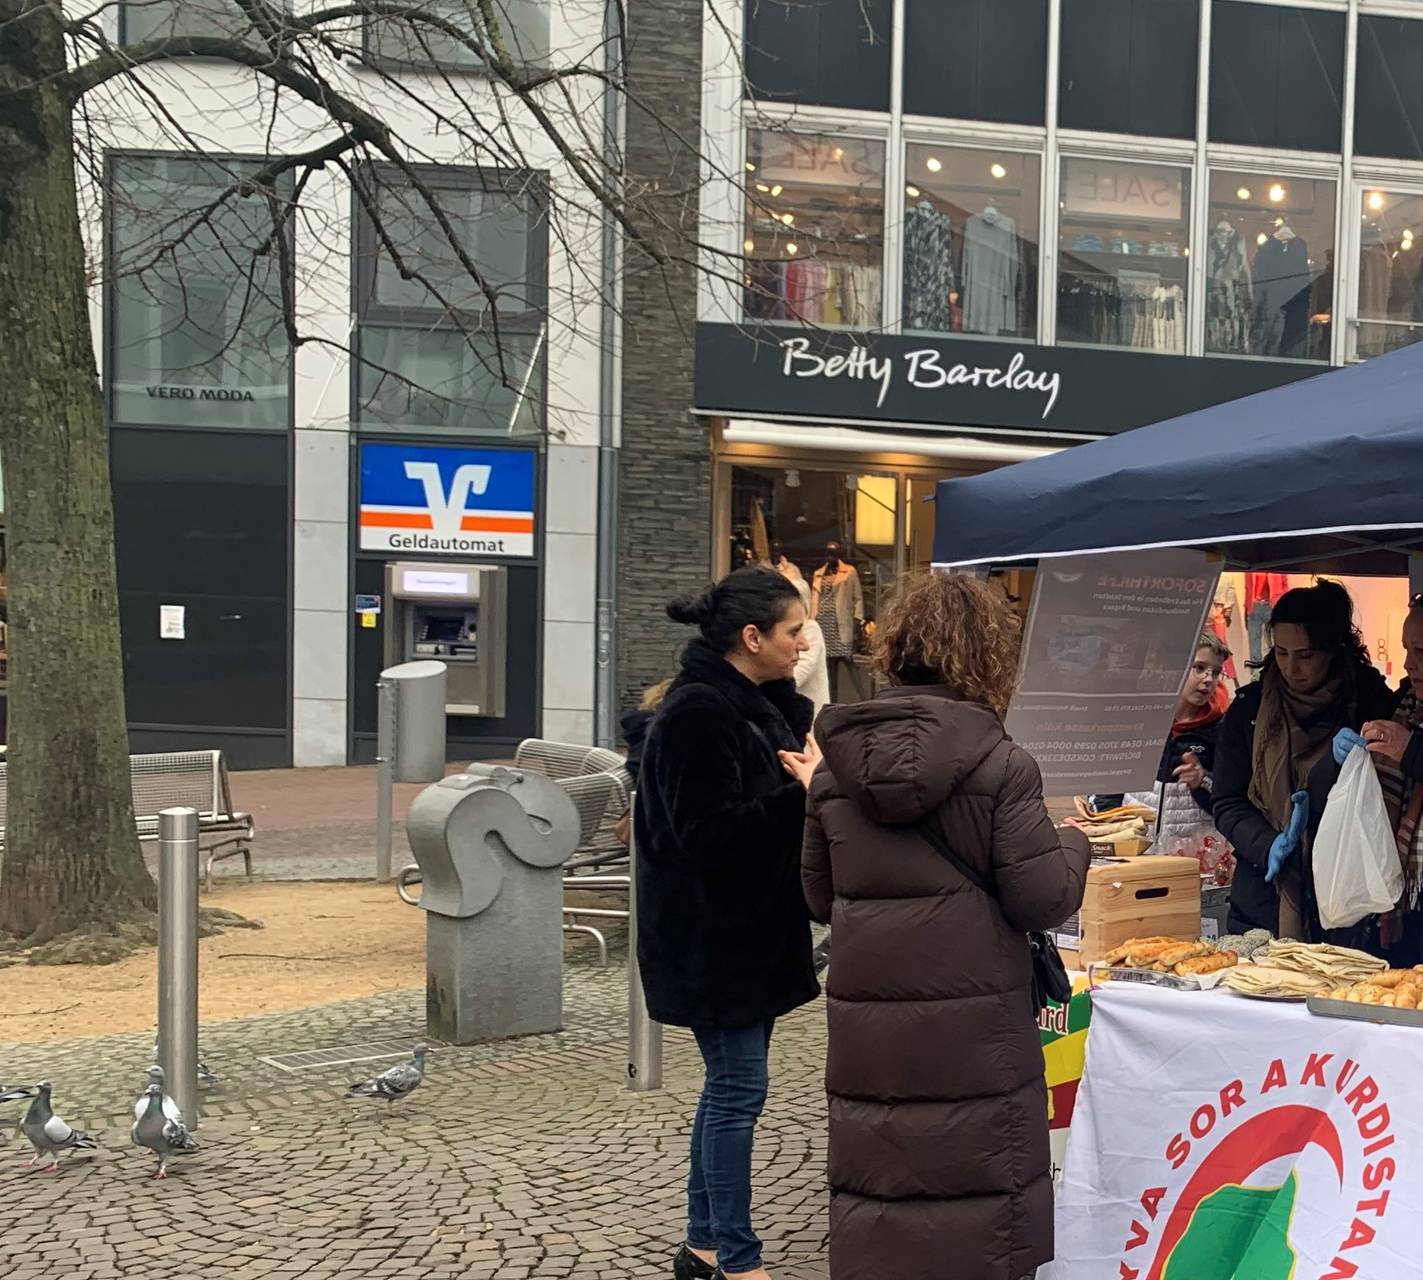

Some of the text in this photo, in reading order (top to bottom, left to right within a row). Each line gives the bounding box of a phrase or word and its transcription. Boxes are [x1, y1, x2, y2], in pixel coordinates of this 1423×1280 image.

[145, 386, 255, 401] VERO MODA
[780, 337, 1060, 419] Betty Barclay
[388, 533, 505, 553] Geldautomat
[1164, 1078, 1247, 1170] SOR
[1260, 1058, 1288, 1095] A
